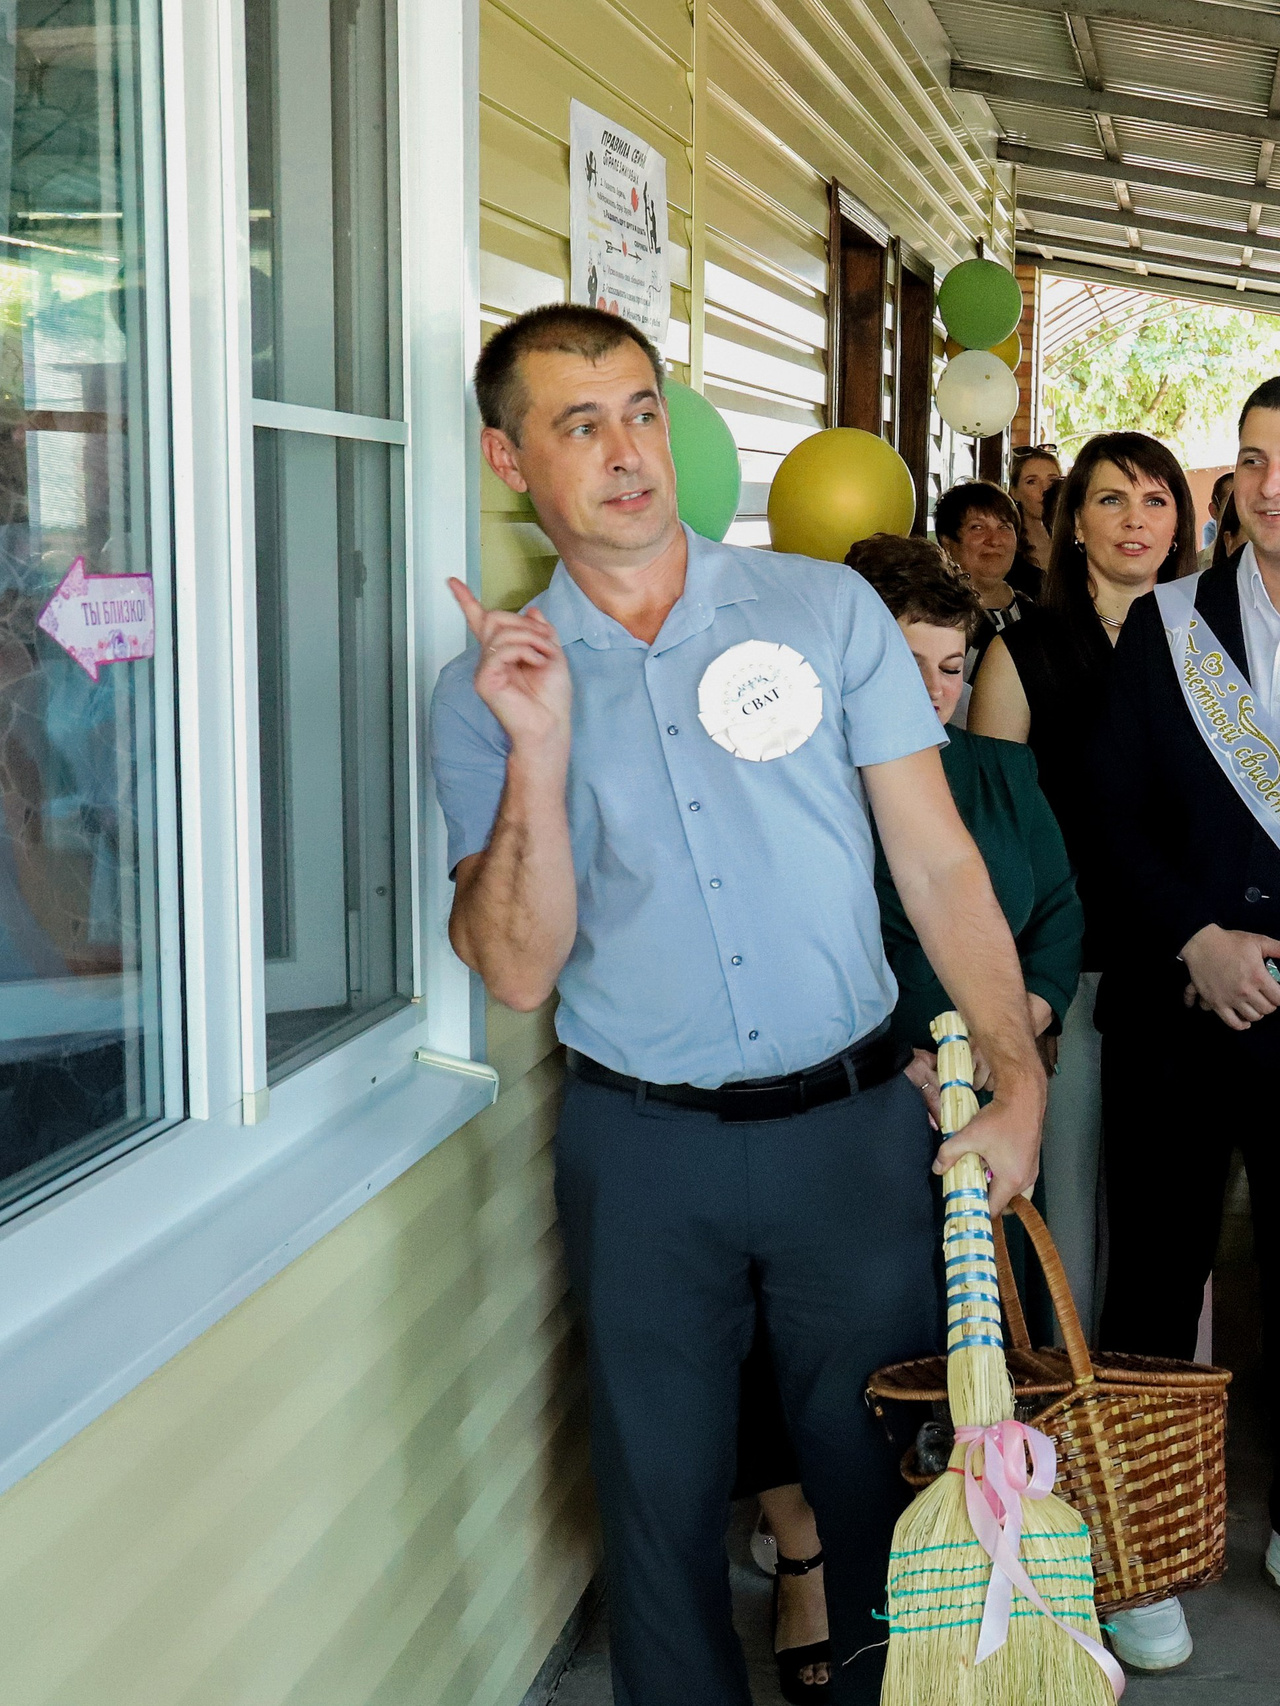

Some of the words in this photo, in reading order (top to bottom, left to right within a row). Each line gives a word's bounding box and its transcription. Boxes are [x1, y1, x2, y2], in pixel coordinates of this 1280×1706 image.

[601, 130, 631, 159] ПРАВИЛА
[81, 602, 101, 626] ТЫ
[103, 600, 146, 624] БЛИЗКО!
[741, 686, 781, 715] СВАТ
